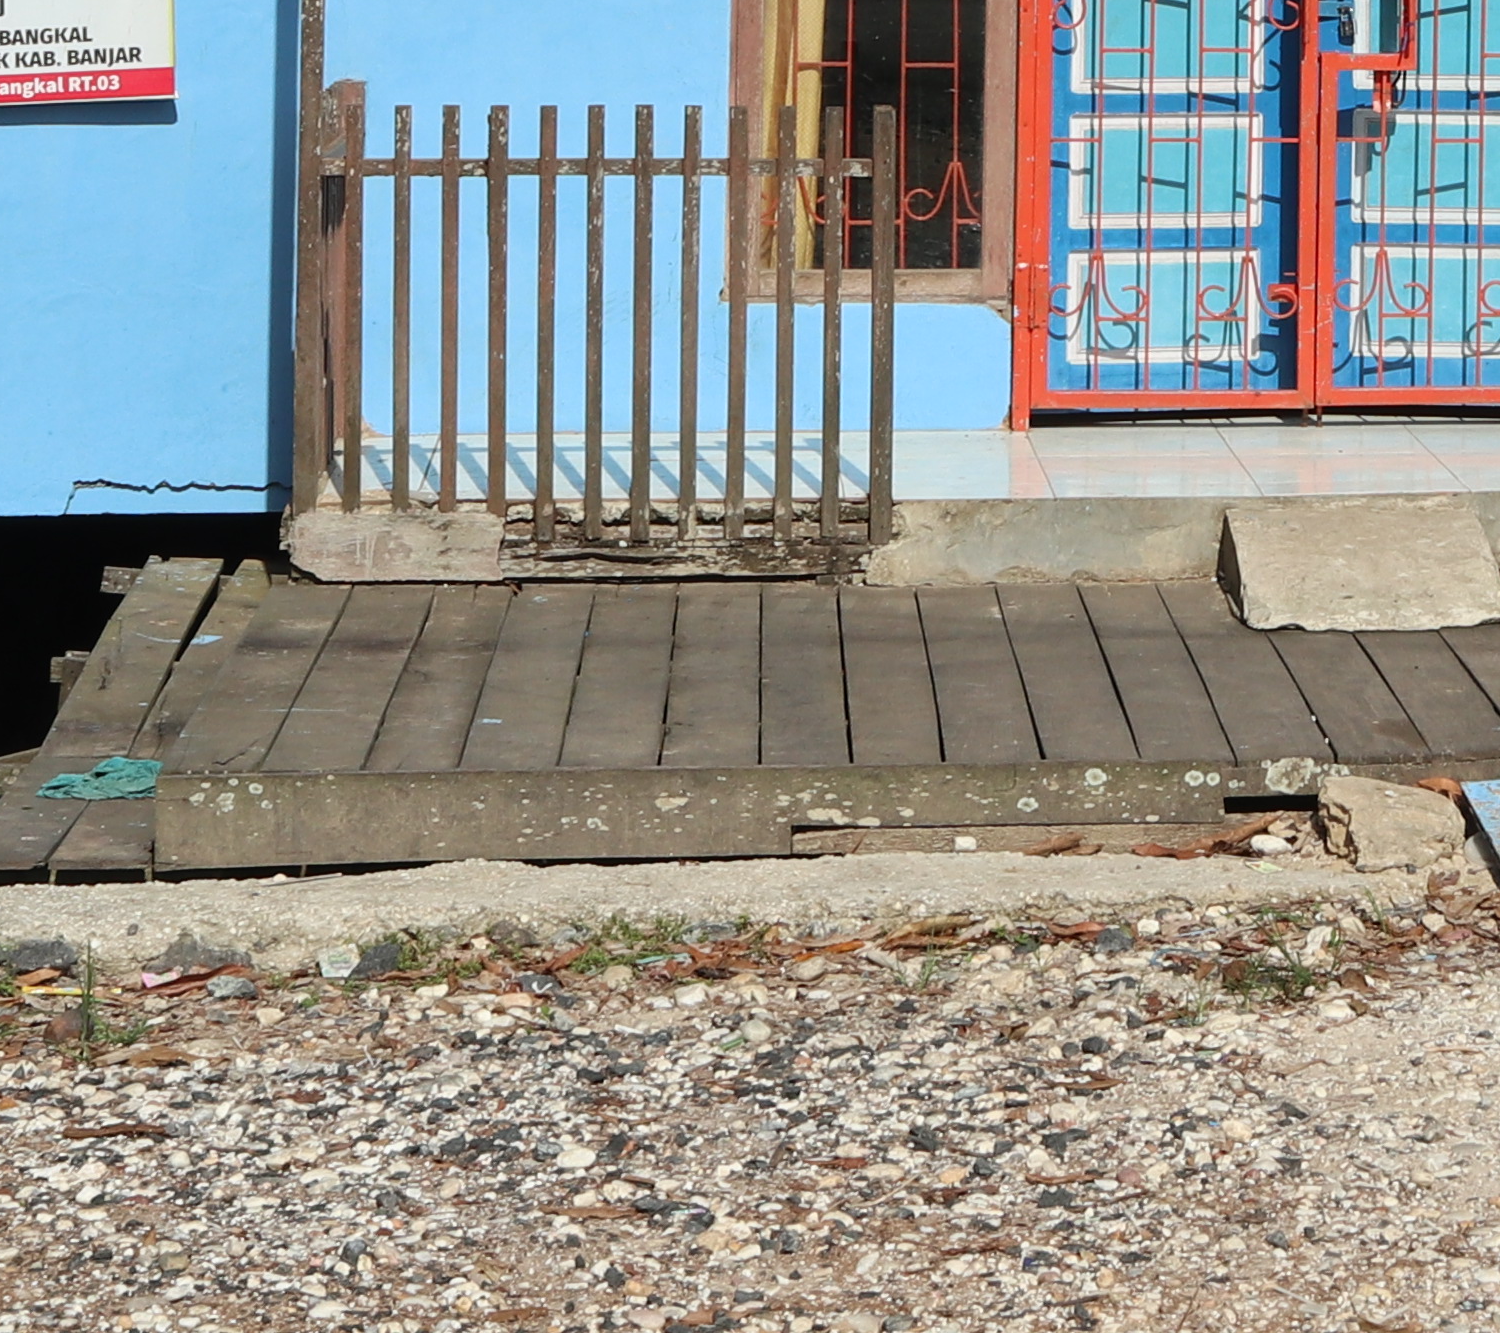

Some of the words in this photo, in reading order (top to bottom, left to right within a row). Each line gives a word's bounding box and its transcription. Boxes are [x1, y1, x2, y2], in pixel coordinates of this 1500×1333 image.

[0, 27, 92, 46] BANGKAL
[15, 50, 61, 69] KAB.
[67, 46, 142, 66] BANJAR
[68, 74, 120, 93] RT.03
